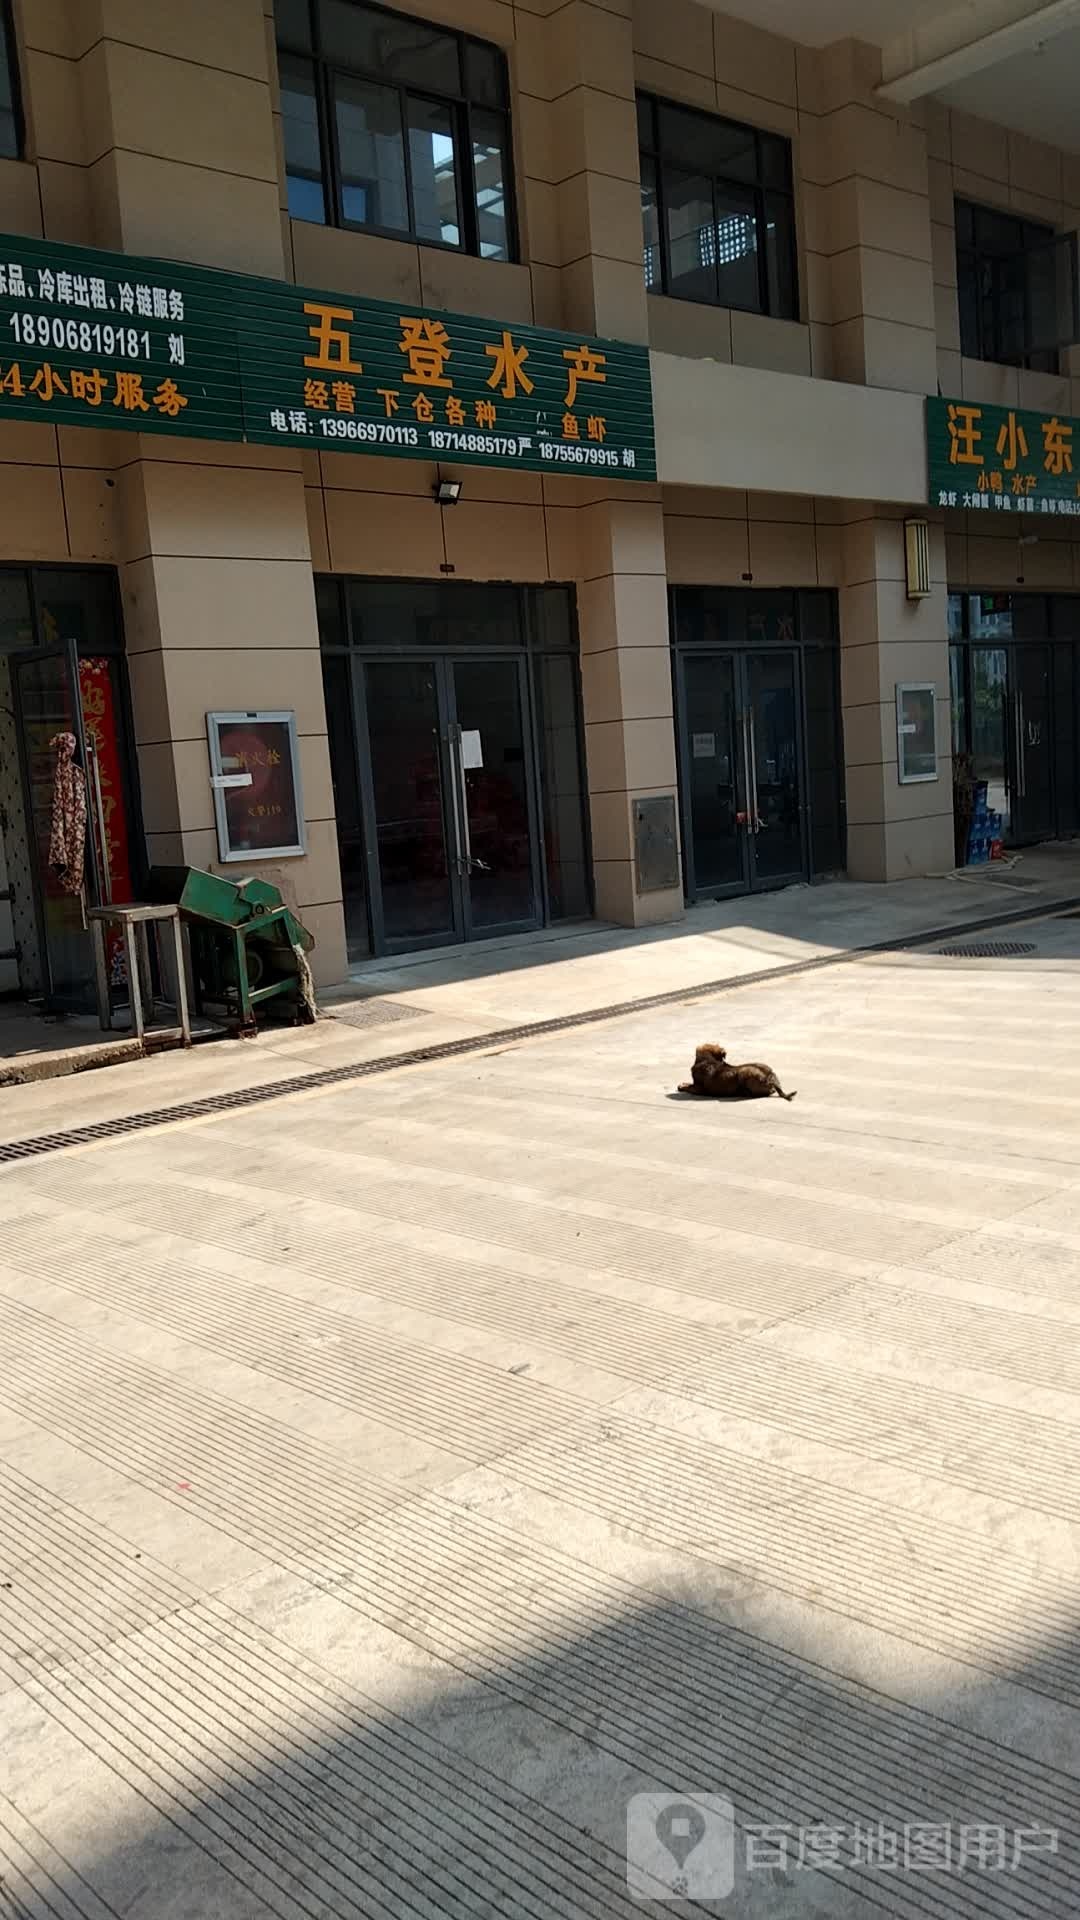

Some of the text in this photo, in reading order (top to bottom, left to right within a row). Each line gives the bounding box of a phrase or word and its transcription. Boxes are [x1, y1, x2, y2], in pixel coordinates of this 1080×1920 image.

[10, 312, 185, 366] 18906819181 刘
[303, 302, 606, 408] 五登水产
[0, 362, 188, 416] 4小时服务
[303, 378, 356, 413] 经营
[561, 412, 607, 443] 鱼虾
[319, 418, 418, 445] 13966970113
[539, 443, 619, 467] 18755679915
[622, 448, 636, 468] 胡
[947, 404, 1073, 474] 汪小东
